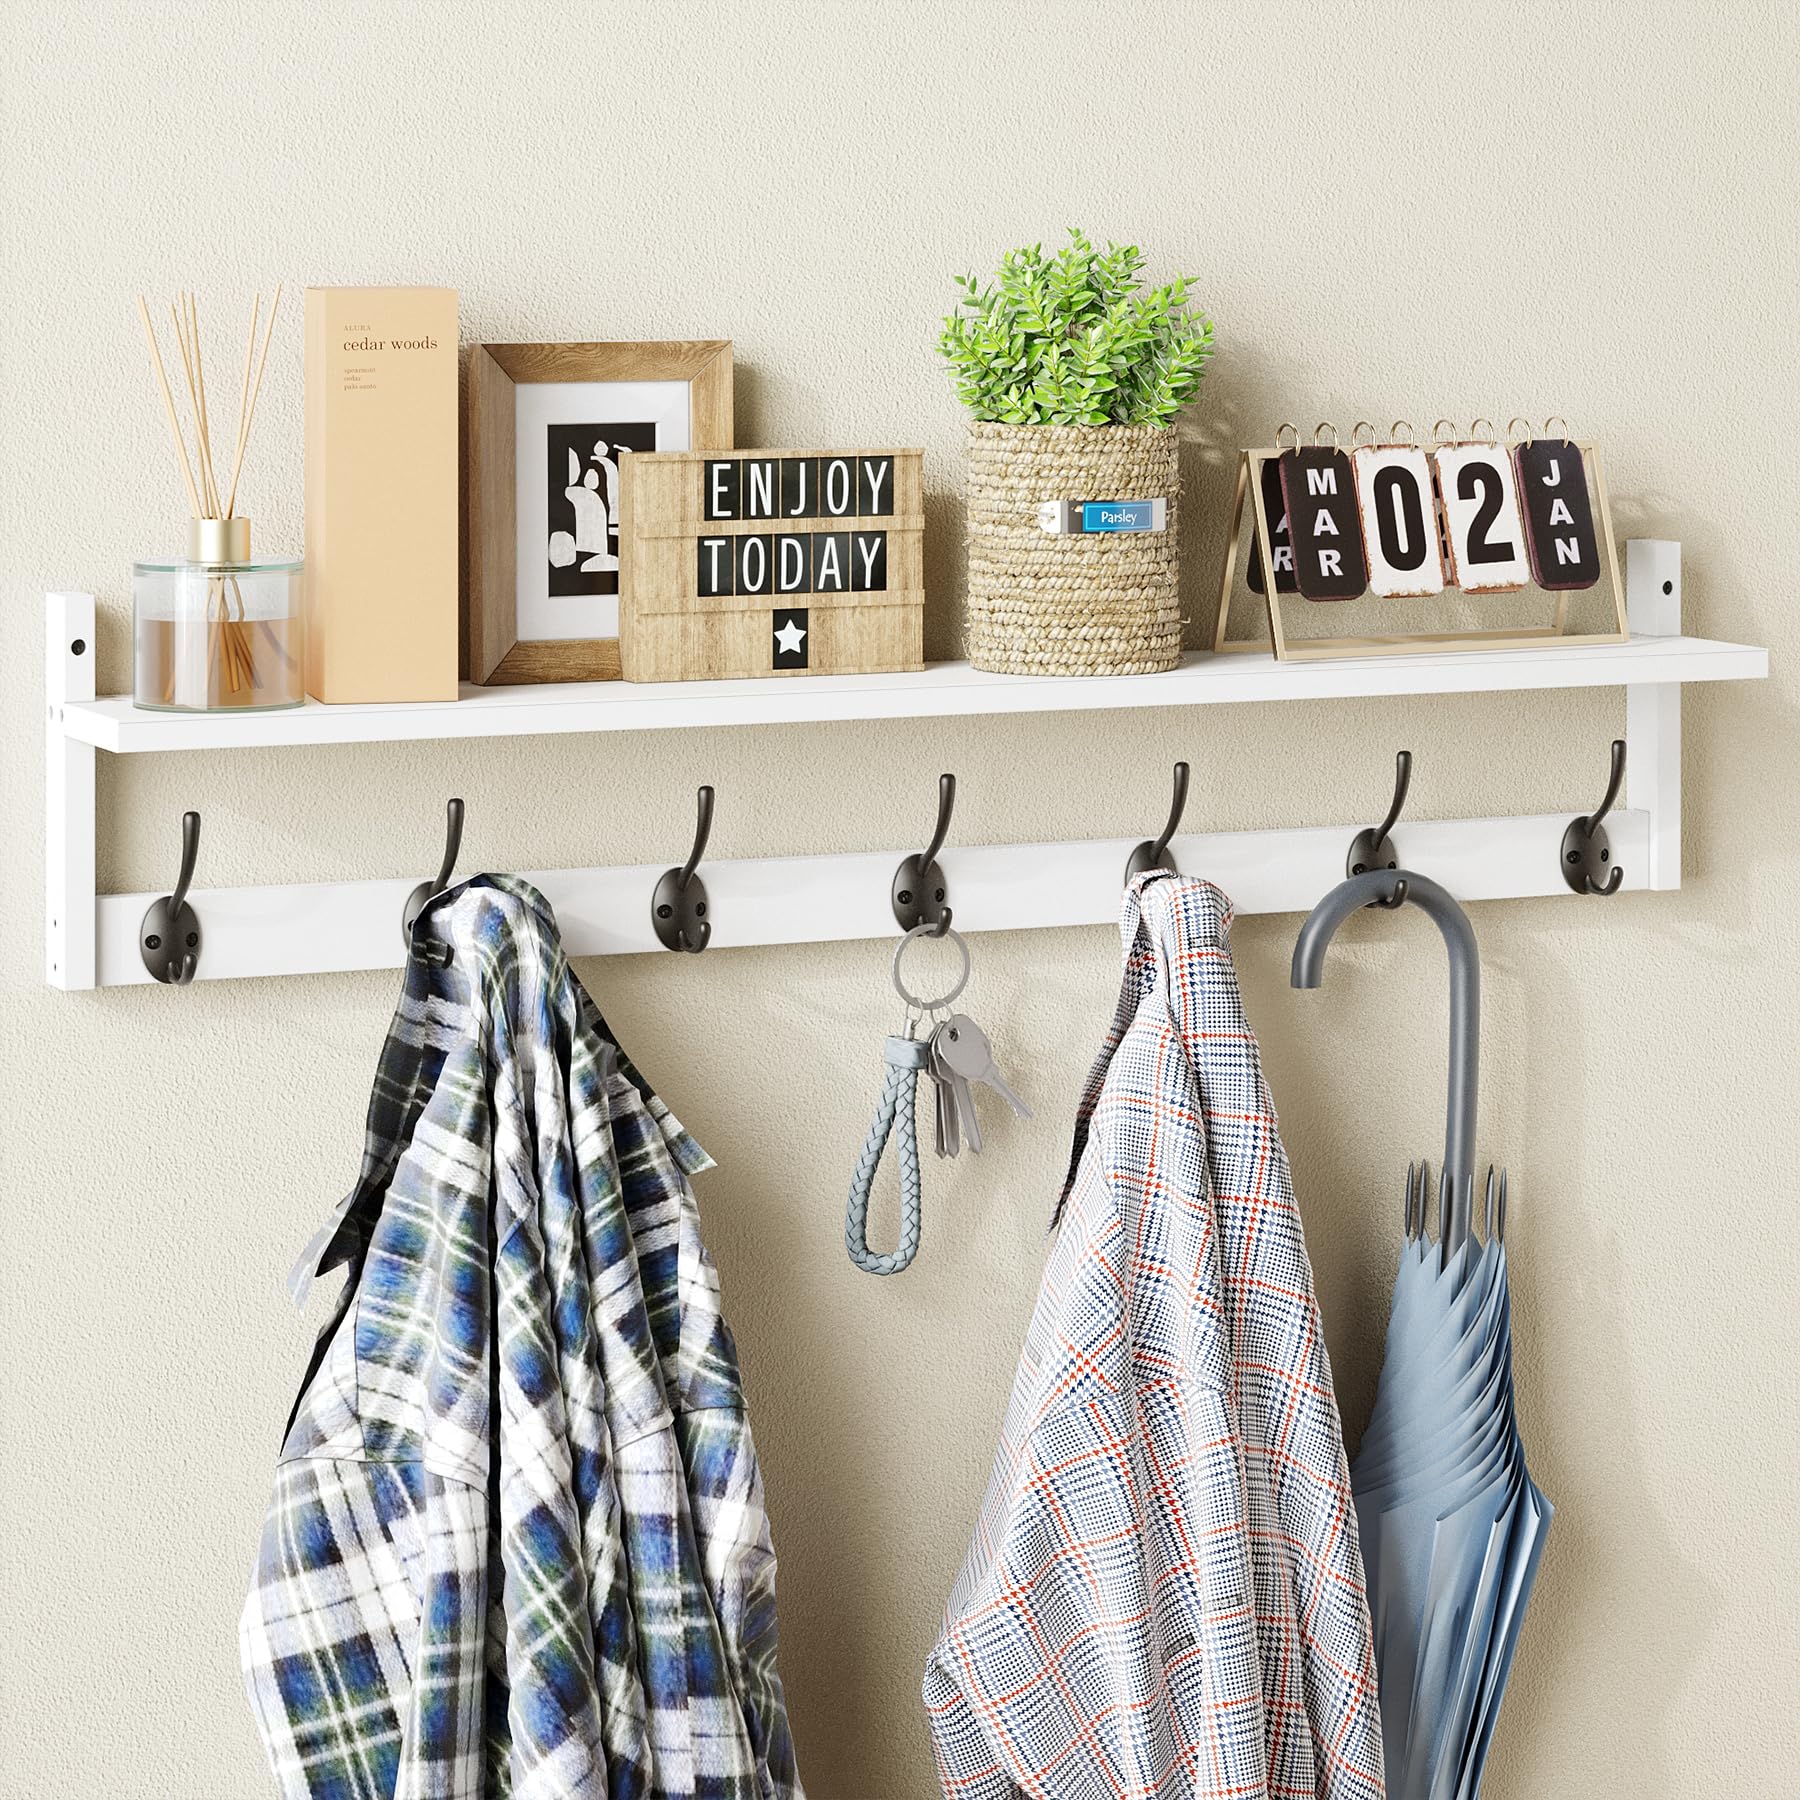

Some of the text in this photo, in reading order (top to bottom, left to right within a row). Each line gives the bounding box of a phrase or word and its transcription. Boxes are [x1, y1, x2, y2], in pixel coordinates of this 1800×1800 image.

[343, 335, 438, 351] cedar woods
[712, 459, 888, 517] ENJOY
[1541, 459, 1581, 566] JAN
[1101, 508, 1138, 526] Parsley
[1306, 468, 1344, 577] MAR
[703, 536, 882, 593] TODAY
